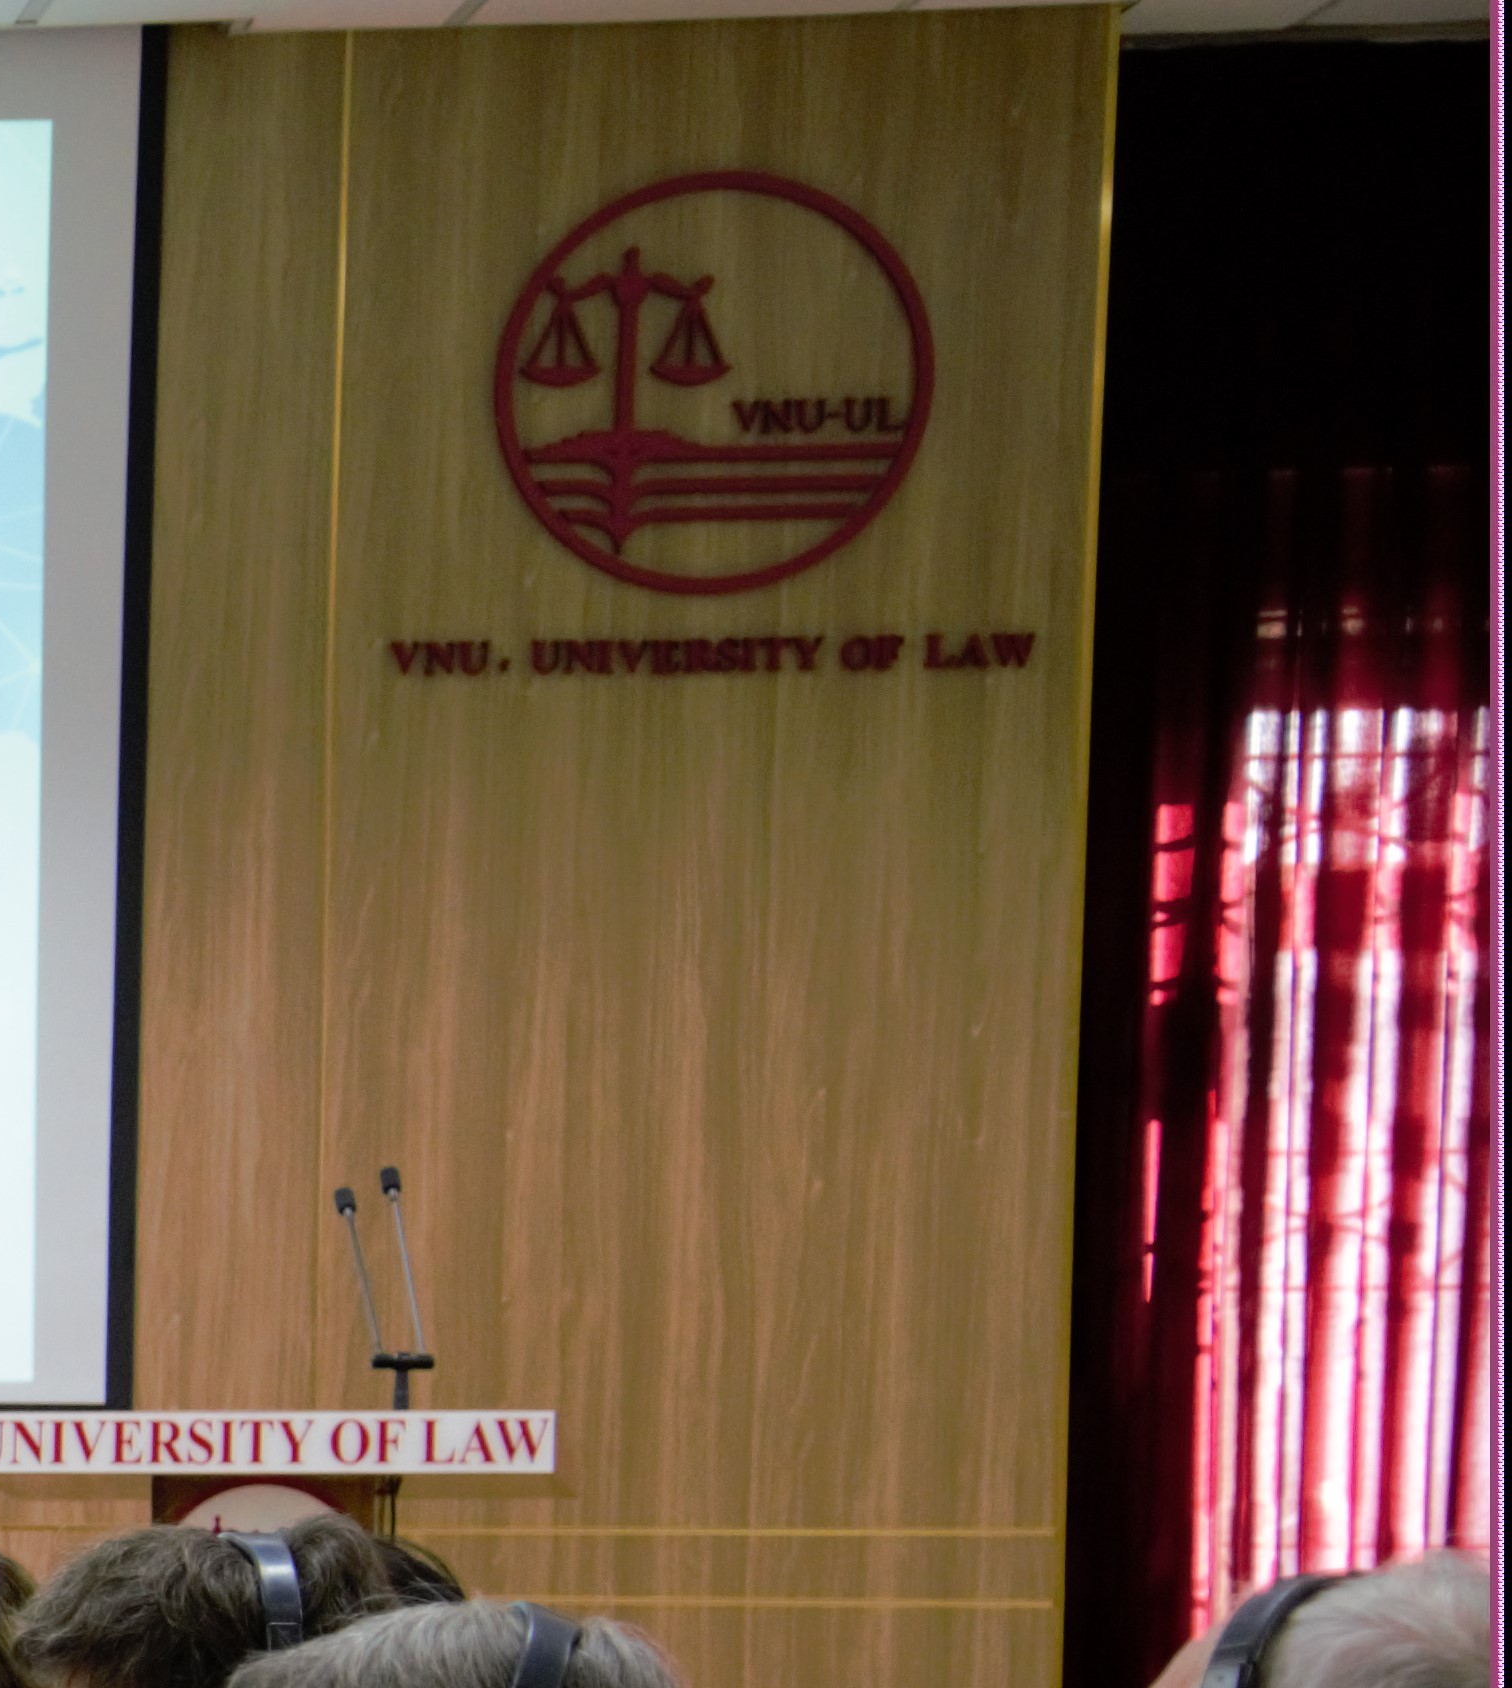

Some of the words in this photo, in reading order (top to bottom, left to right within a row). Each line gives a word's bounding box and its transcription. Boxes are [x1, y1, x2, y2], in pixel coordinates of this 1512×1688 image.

[731, 397, 906, 434] VNU-UL
[531, 637, 824, 675] UNIVERSITY
[840, 636, 905, 673] OF
[924, 633, 1035, 670] LAW
[330, 1418, 406, 1465] OF
[421, 1418, 550, 1464] LAW
